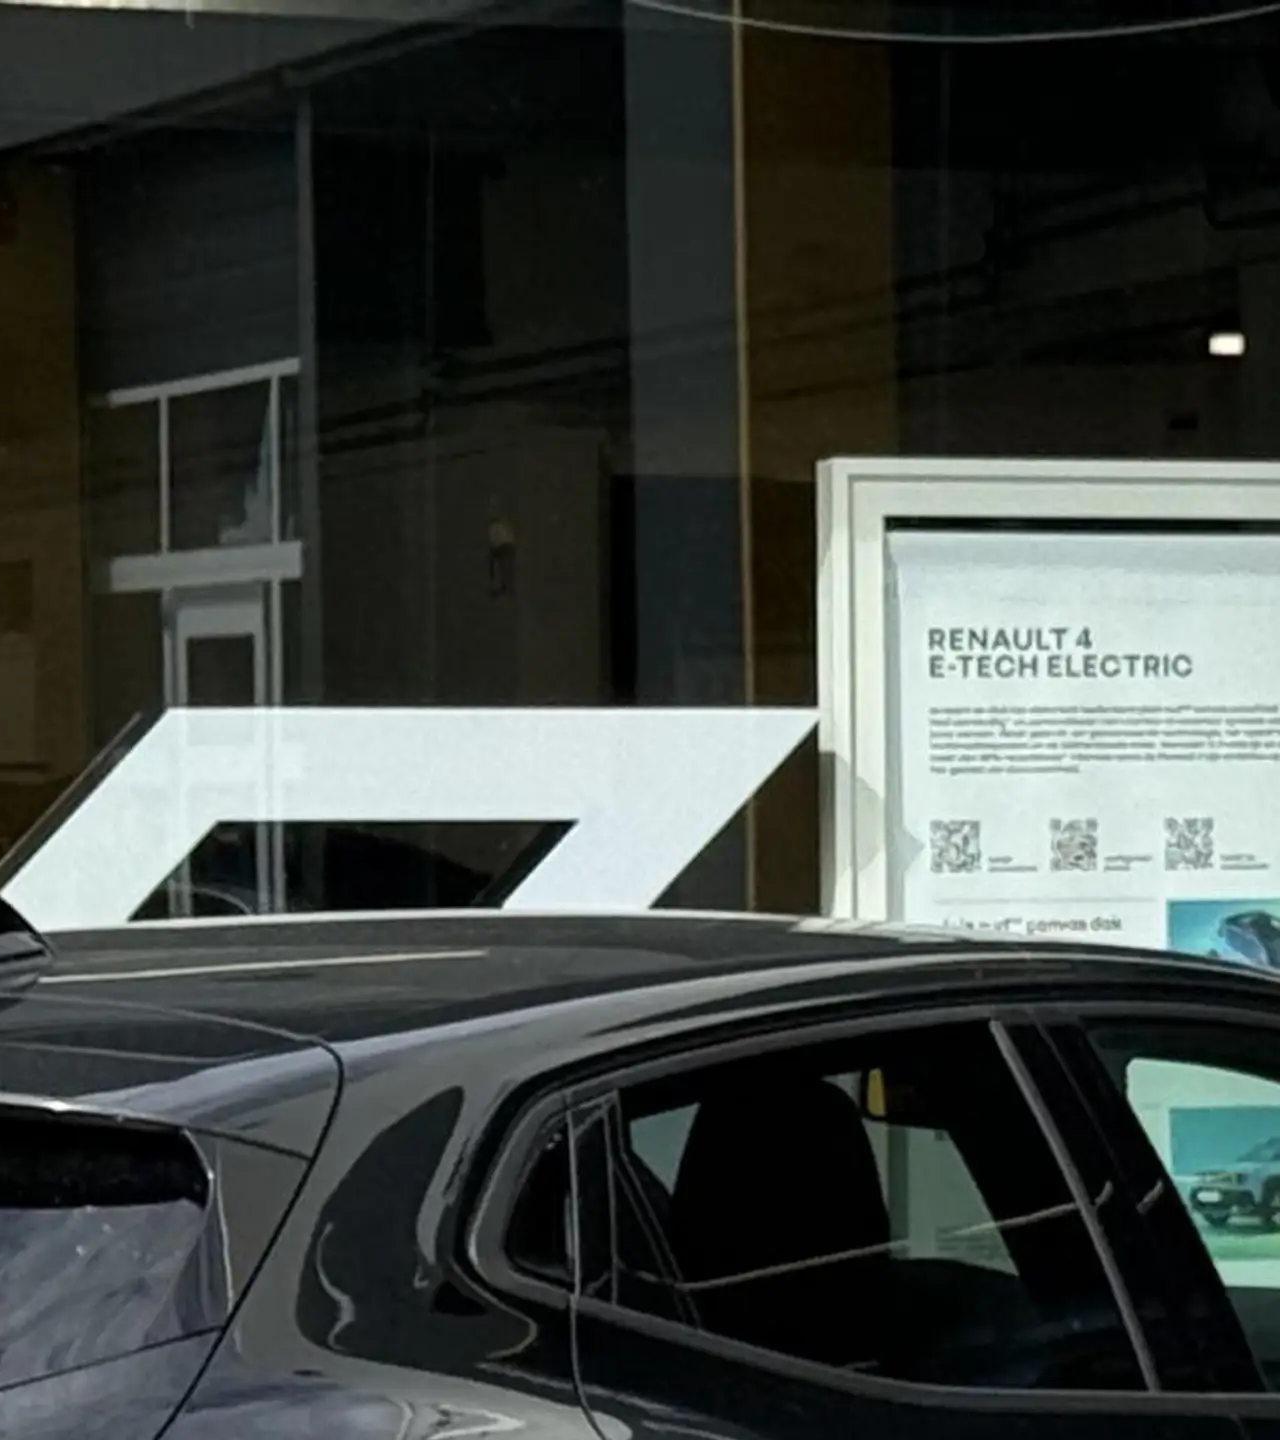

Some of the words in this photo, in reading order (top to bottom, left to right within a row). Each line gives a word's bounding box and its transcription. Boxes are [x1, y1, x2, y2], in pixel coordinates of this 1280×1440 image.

[928, 628, 1069, 651] RENAULT
[1075, 627, 1093, 650] 4
[929, 654, 1039, 678] E-TECH
[1047, 654, 1194, 678] ELECTRIC
